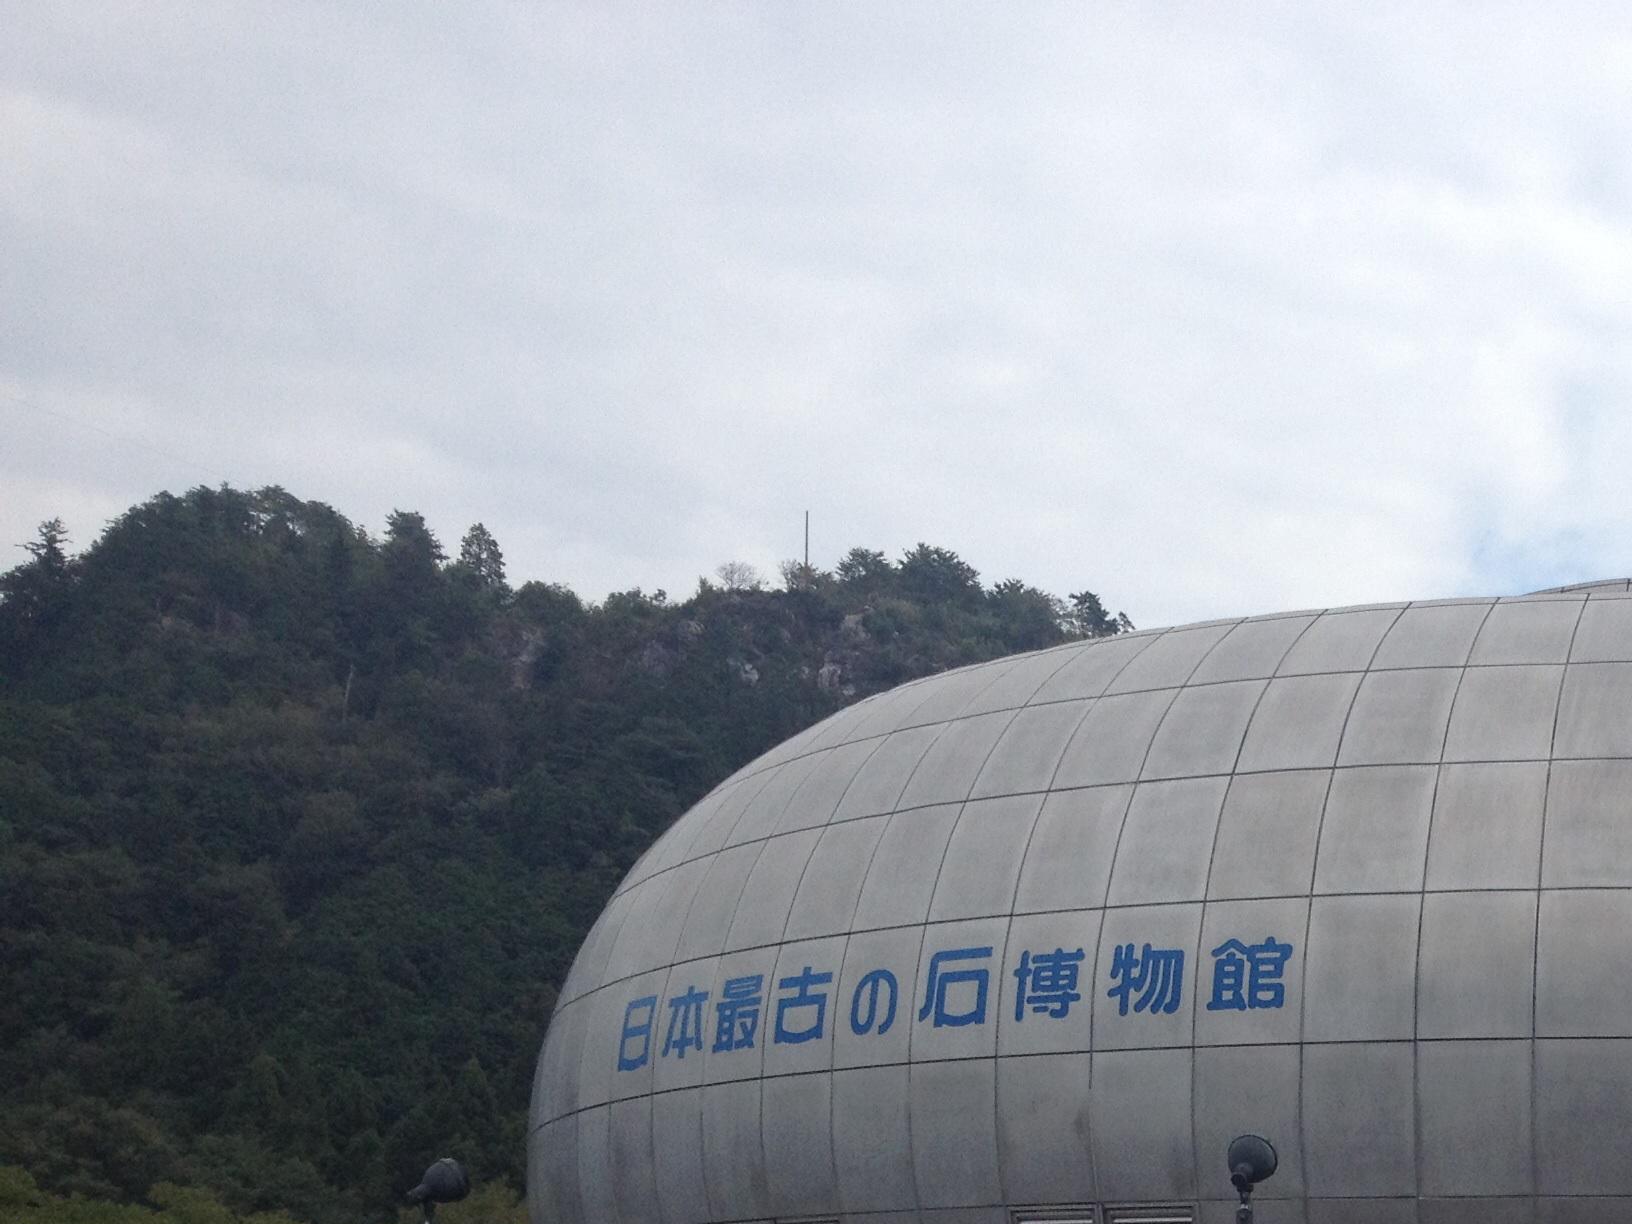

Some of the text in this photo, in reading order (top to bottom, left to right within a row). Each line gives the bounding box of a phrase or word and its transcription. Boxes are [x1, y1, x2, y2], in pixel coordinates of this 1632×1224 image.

[617, 936, 1294, 1072] 日本最古の石博物館
